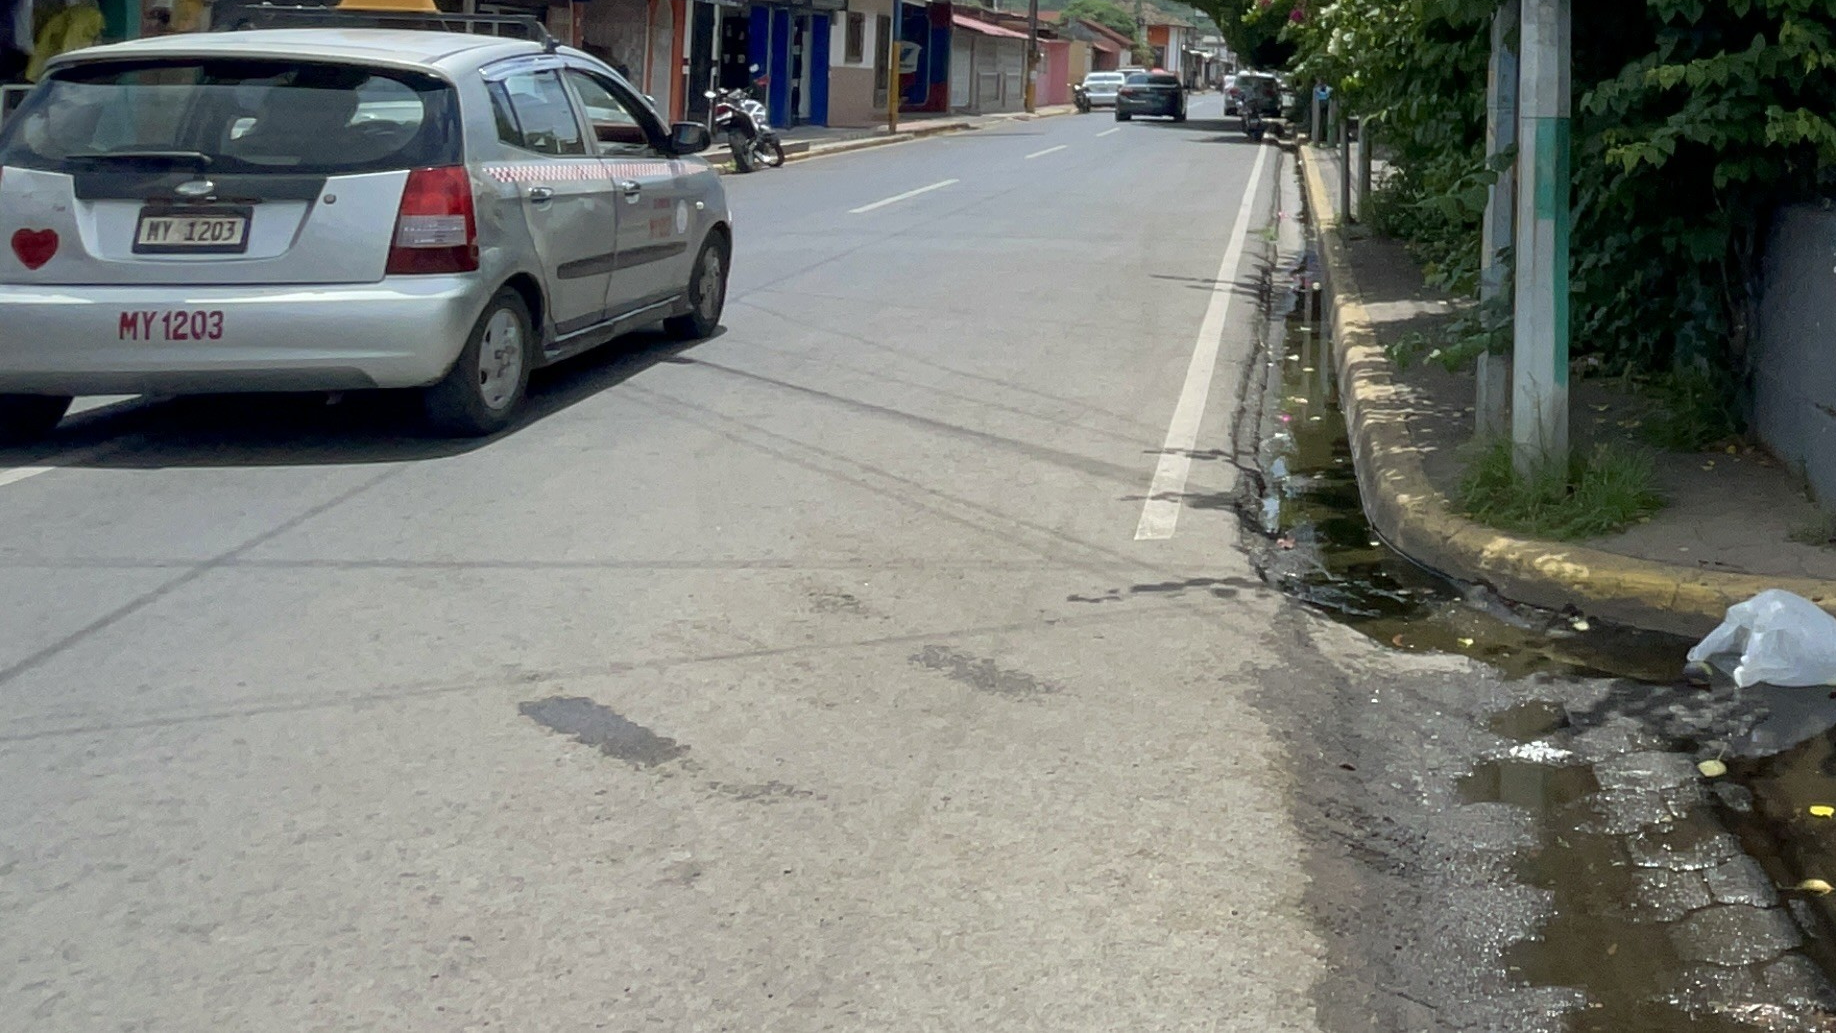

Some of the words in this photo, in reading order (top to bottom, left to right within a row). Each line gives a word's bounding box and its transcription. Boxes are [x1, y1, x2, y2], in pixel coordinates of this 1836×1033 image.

[147, 221, 173, 241] MY
[183, 220, 237, 242] 1203
[119, 311, 158, 340] MY
[162, 310, 224, 341] 1203
